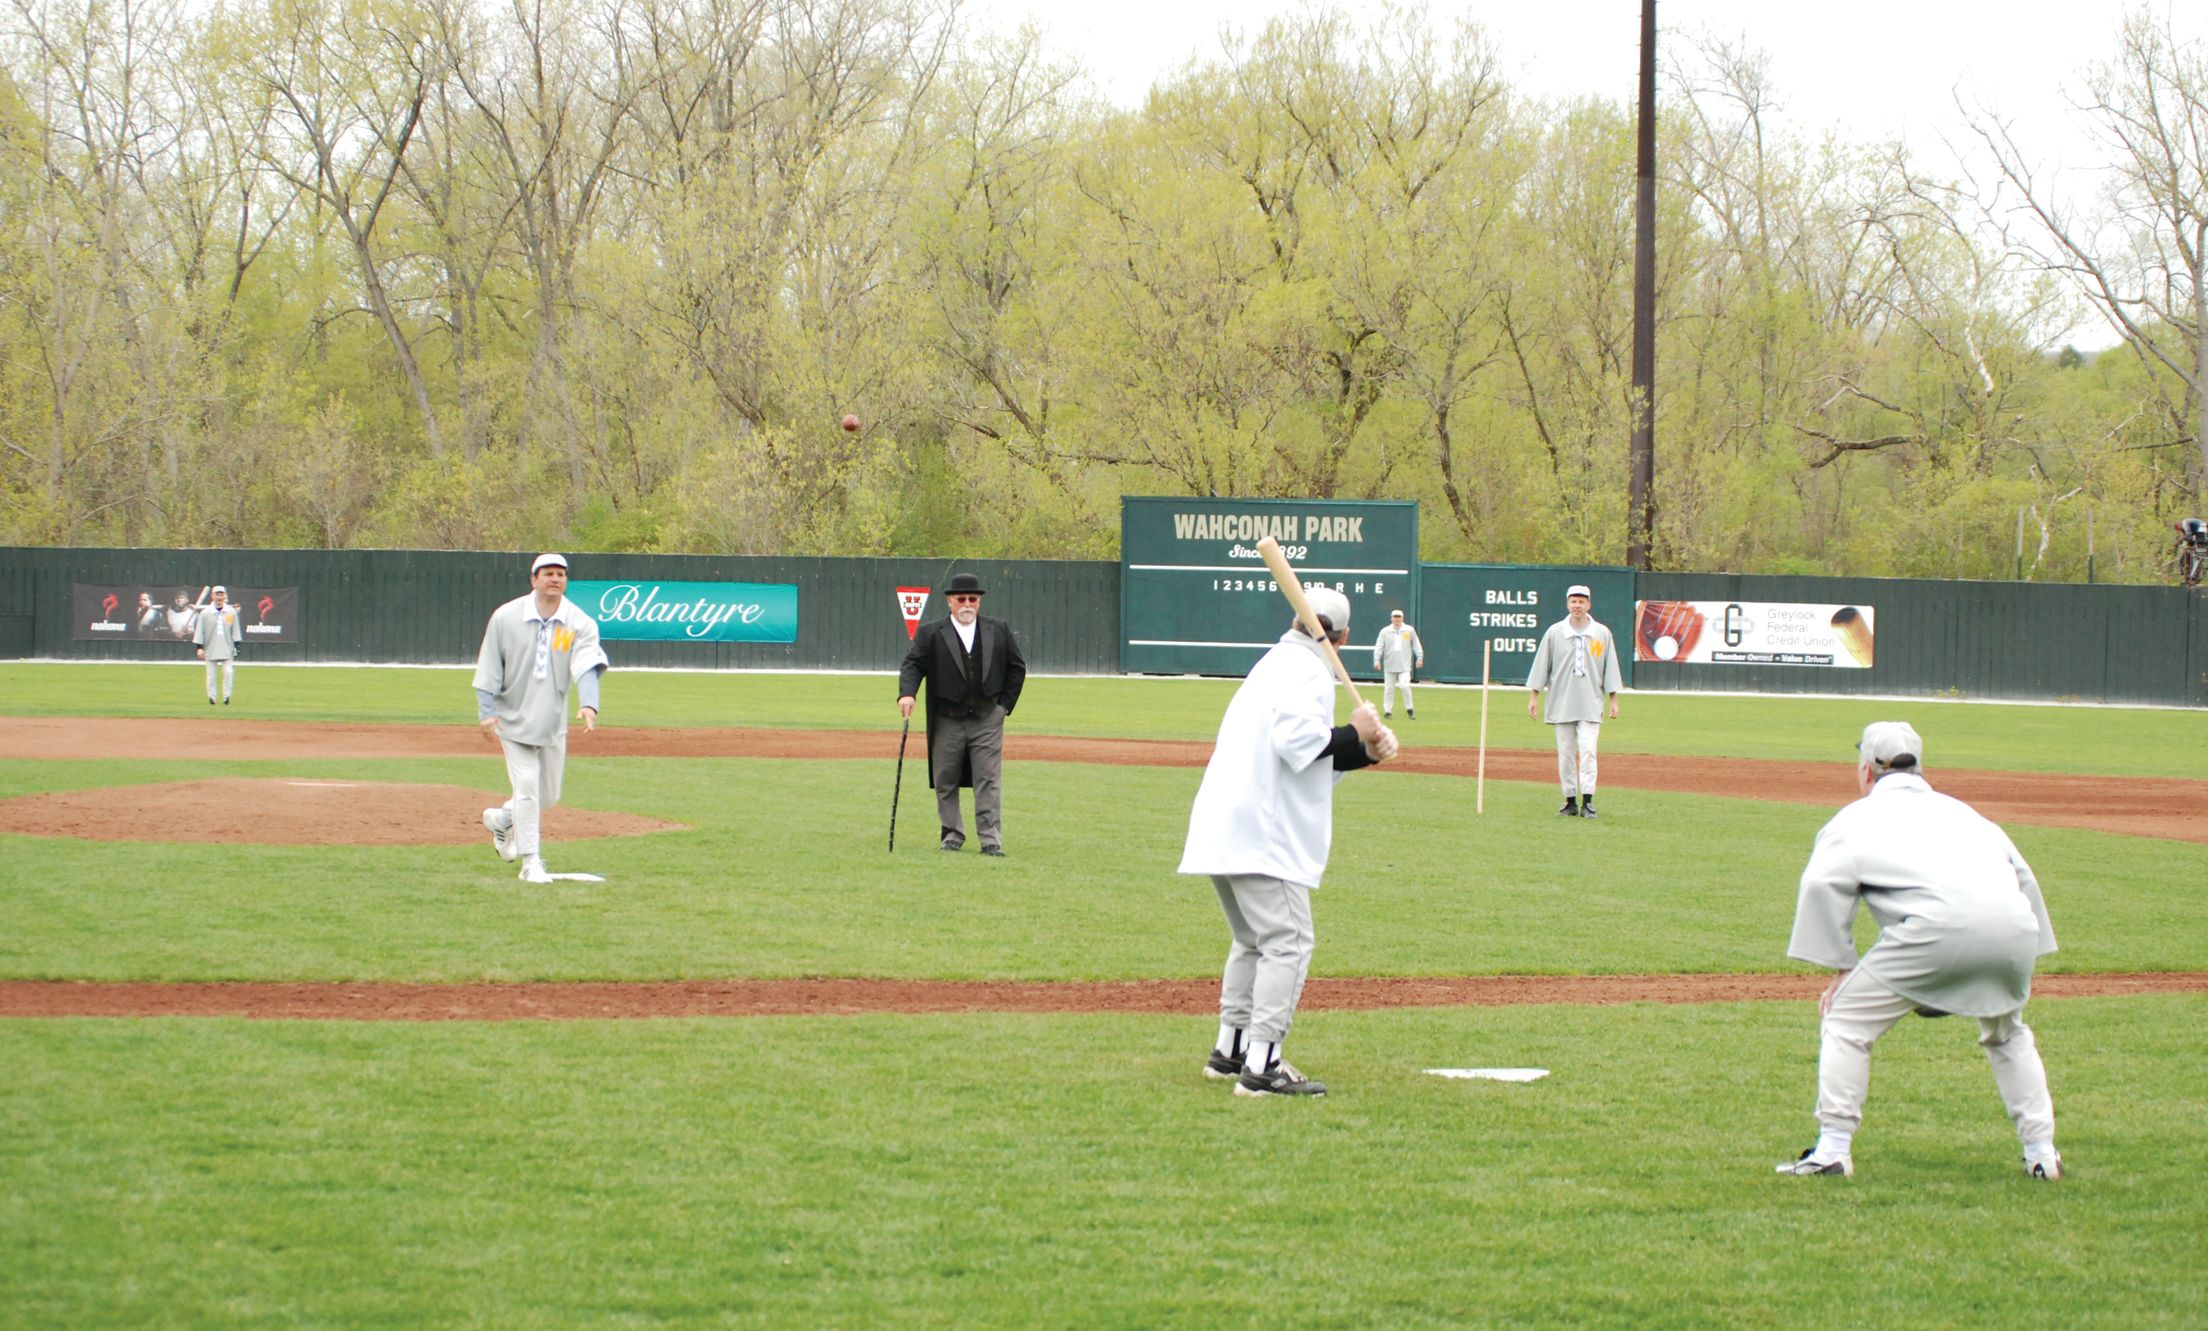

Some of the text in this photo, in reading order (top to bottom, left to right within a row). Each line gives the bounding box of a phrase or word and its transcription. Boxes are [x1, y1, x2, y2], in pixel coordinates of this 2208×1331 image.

[1174, 514, 1364, 542] WAHCONAH PARK
[1229, 544, 1263, 558] Sinc
[1213, 579, 1218, 590] 1
[1223, 580, 1231, 591] 2
[1234, 580, 1243, 591] 3
[1246, 580, 1254, 591] 4
[1257, 581, 1266, 592] 5
[1269, 581, 1278, 592] 6
[1336, 582, 1344, 593] R
[1355, 582, 1364, 593] H
[1375, 583, 1384, 594] E
[1485, 590, 1538, 605] BALLS
[598, 584, 764, 638] Blantyre
[1767, 608, 1816, 621] Greylock
[1470, 613, 1537, 628] STRIKES
[1767, 621, 1809, 633] Federal
[1494, 637, 1537, 653] OUTS
[1590, 639, 1606, 656] W
[1767, 635, 1836, 647] Credit Union
[1714, 652, 1746, 661] Member
[1747, 653, 1773, 662] Owned
[1781, 654, 1803, 663] Value
